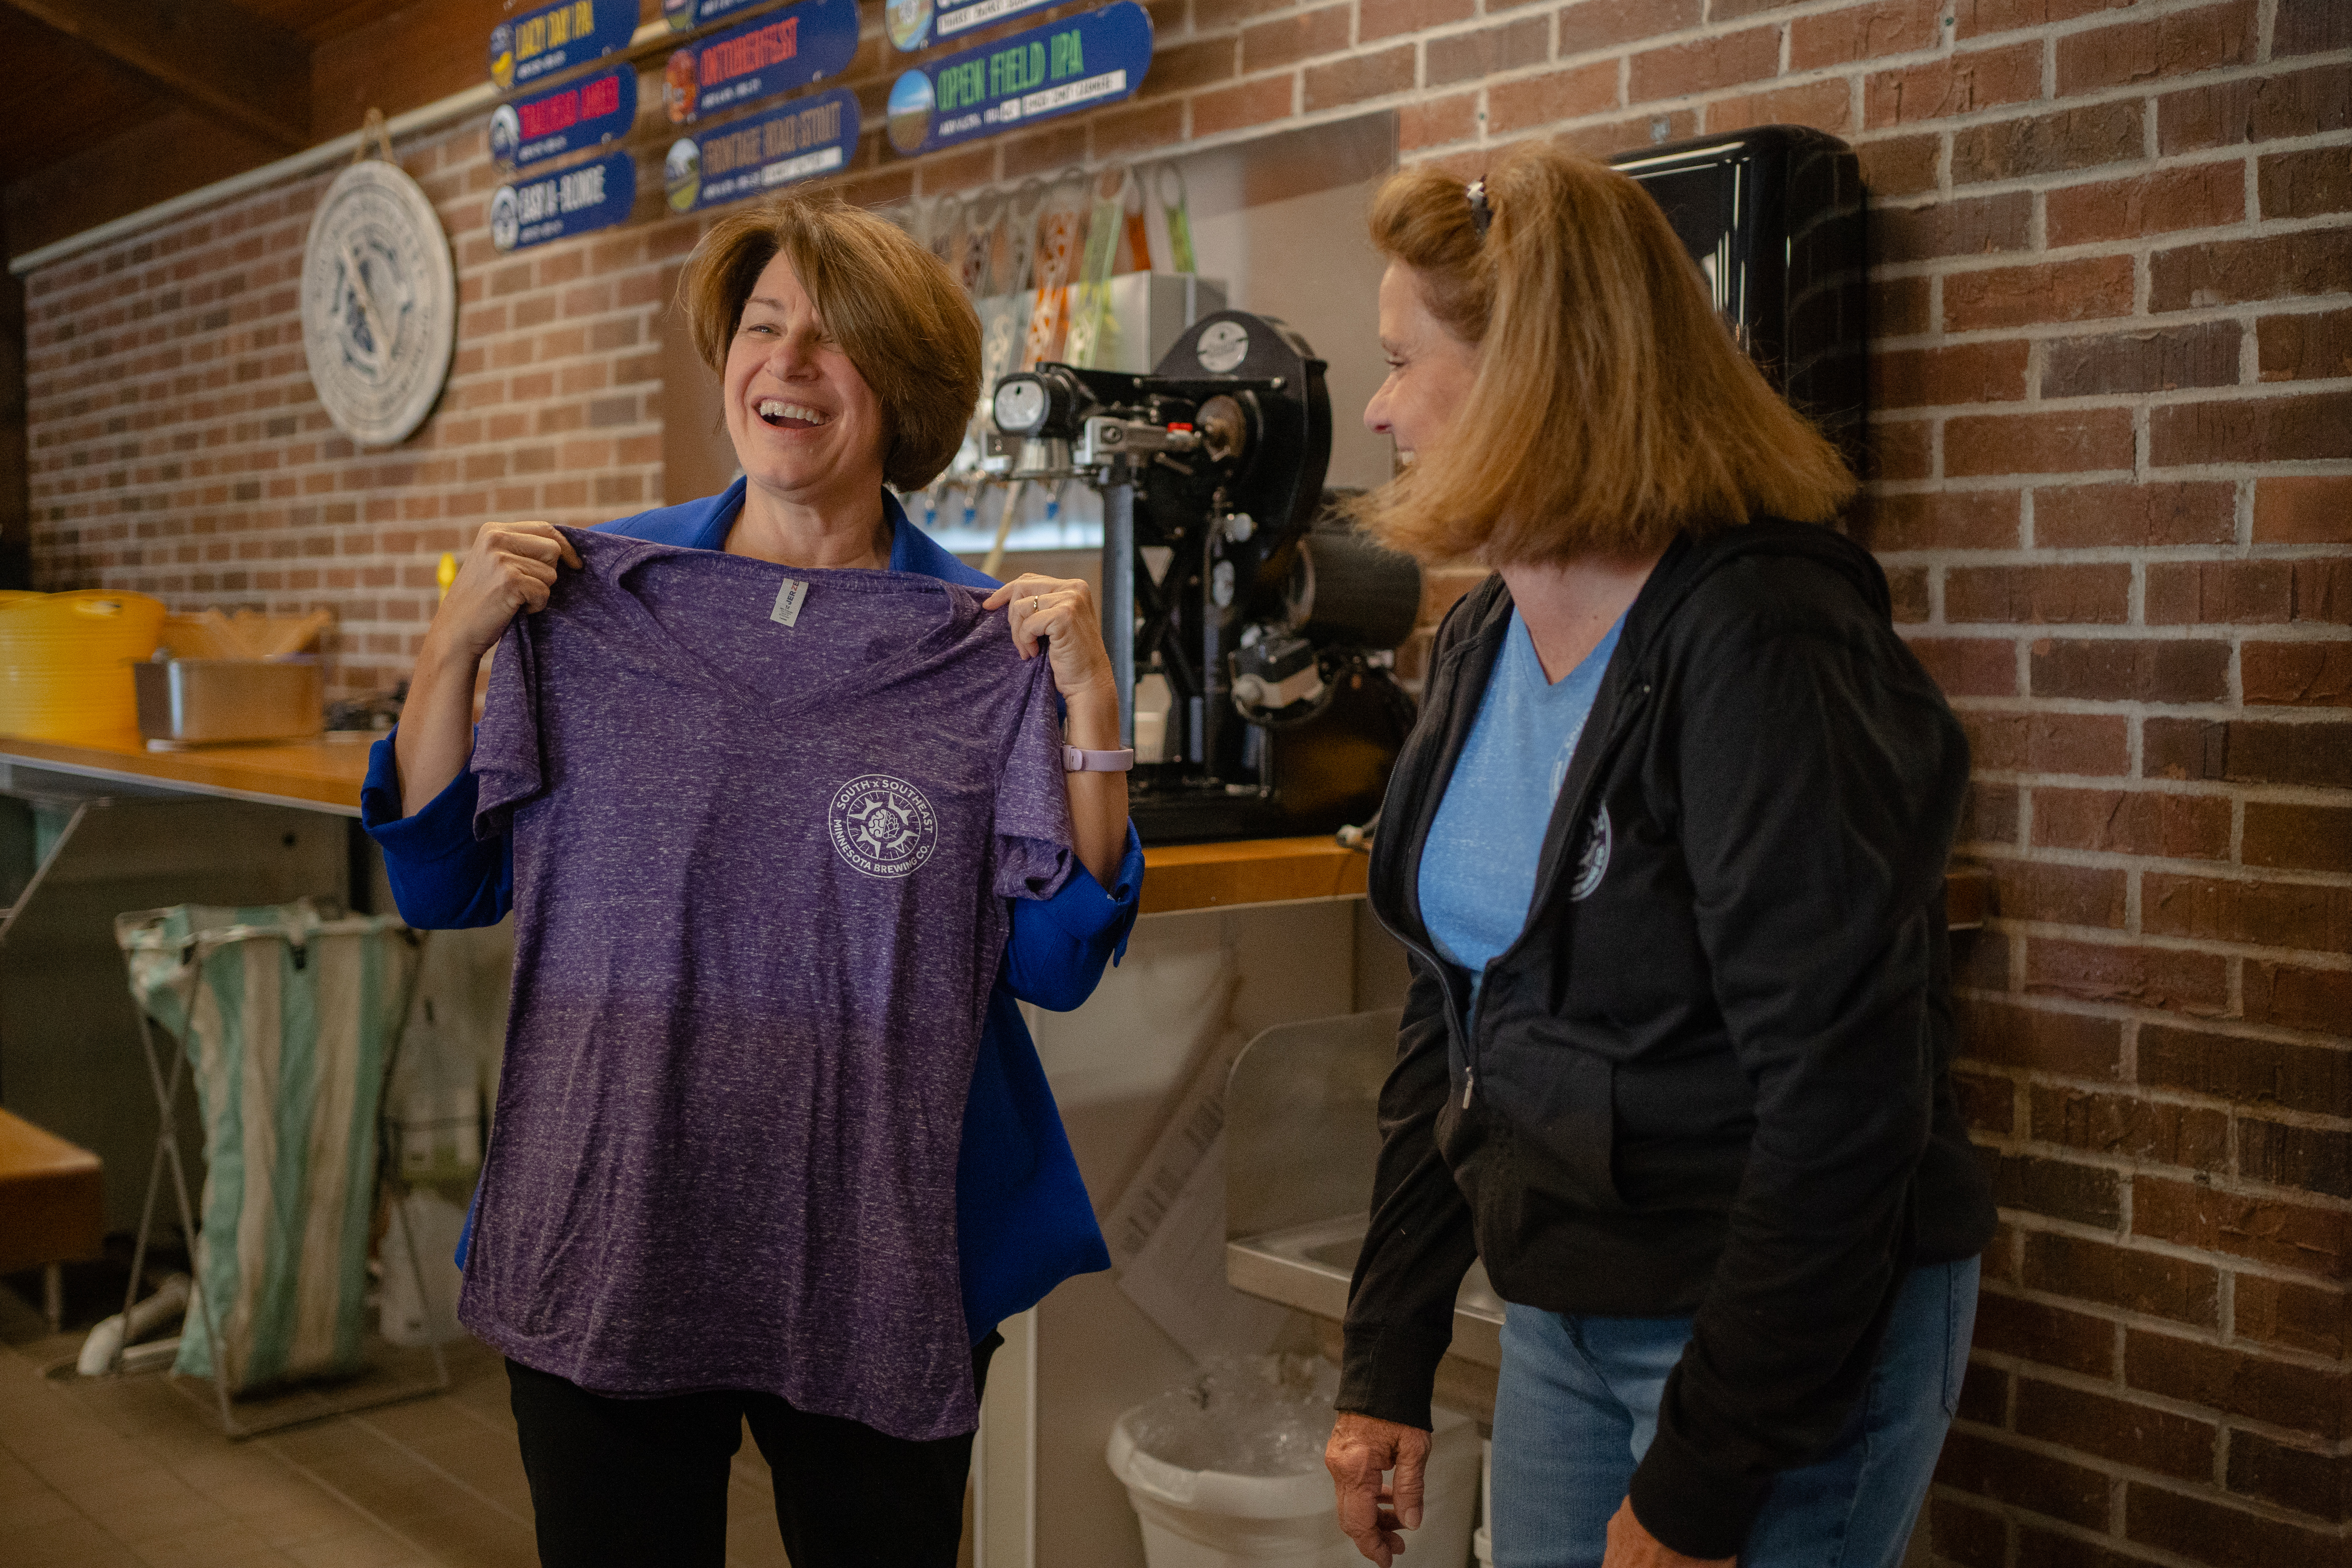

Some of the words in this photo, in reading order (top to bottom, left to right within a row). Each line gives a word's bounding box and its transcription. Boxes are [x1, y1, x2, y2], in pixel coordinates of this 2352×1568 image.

[700, 16, 800, 86] OKTOBERFEST
[937, 58, 985, 112] OPEN
[990, 41, 1046, 97] FIELD
[1051, 29, 1084, 80] IPA
[837, 780, 871, 810] SOUTH
[882, 780, 933, 833] SOUTHEAST
[834, 819, 871, 870] MINNESOTA
[875, 857, 917, 873] BREWING
